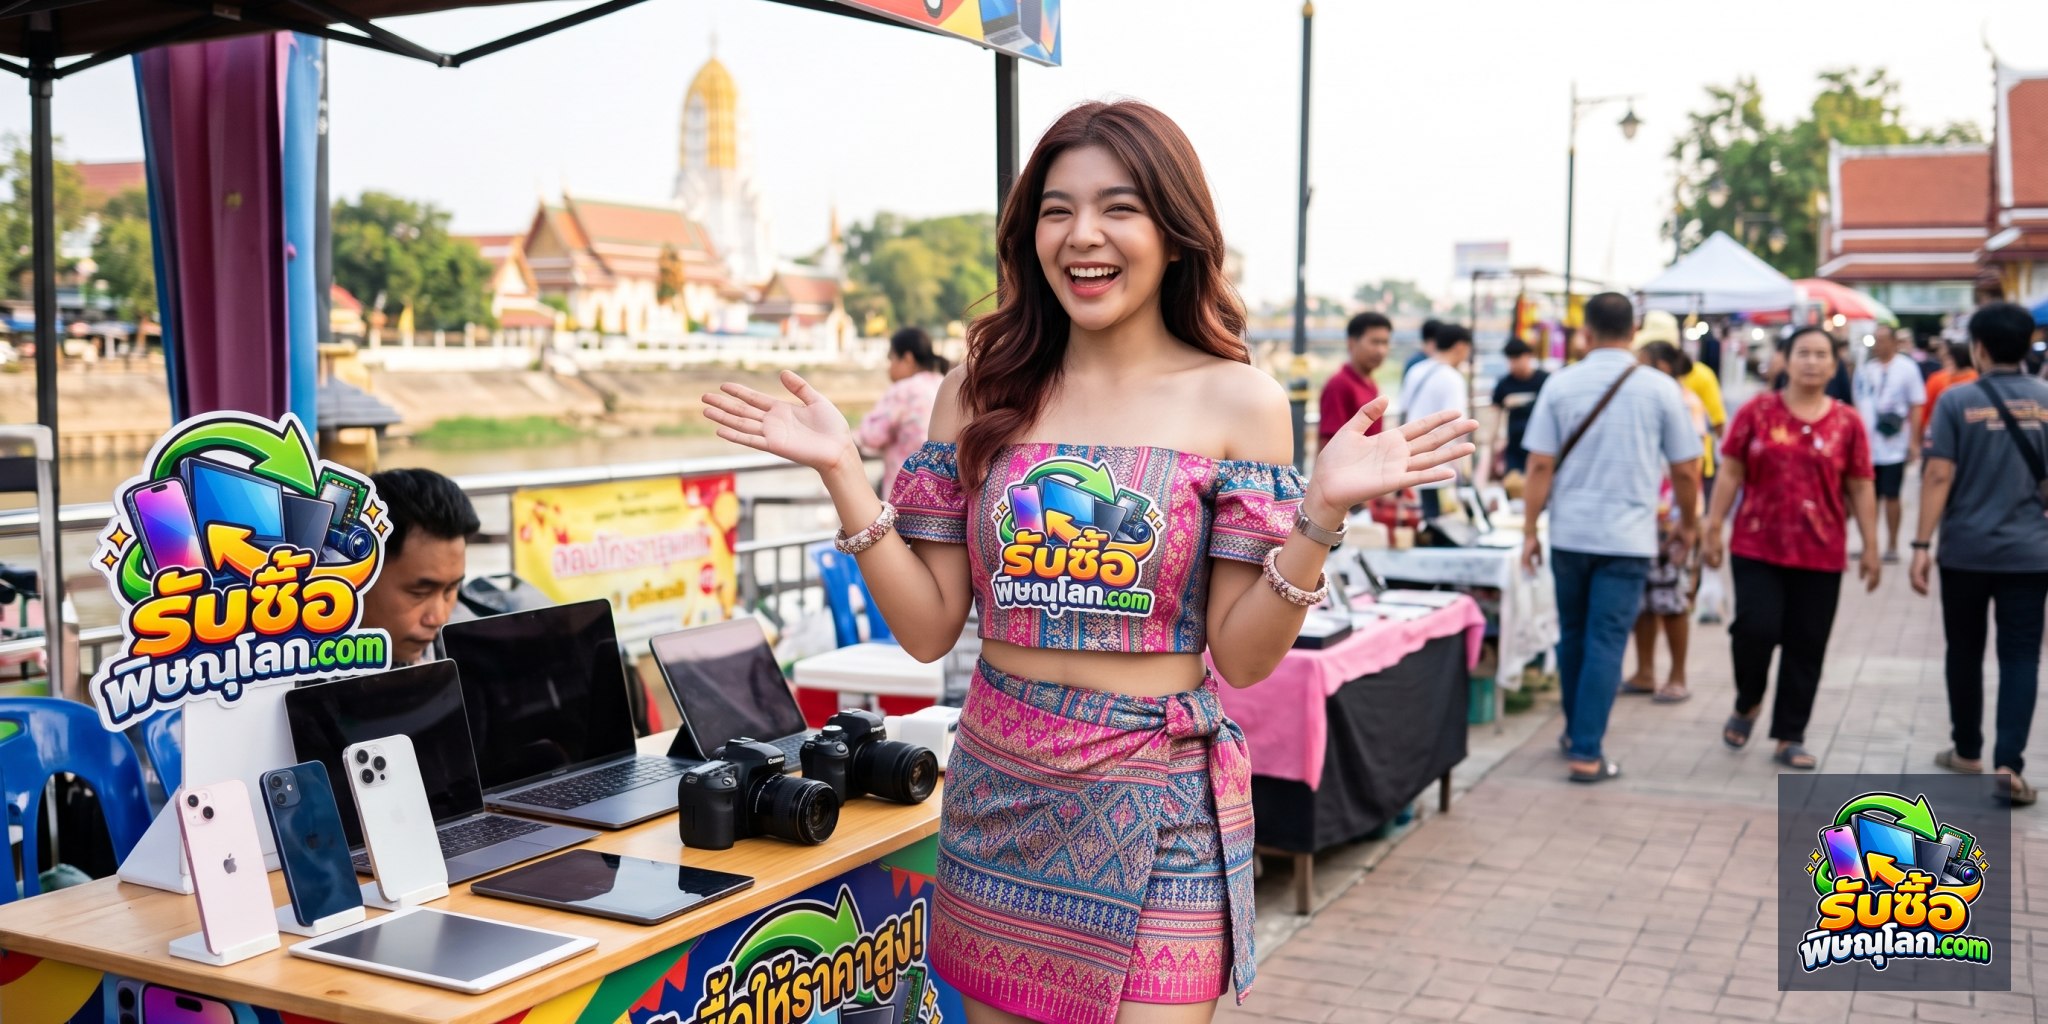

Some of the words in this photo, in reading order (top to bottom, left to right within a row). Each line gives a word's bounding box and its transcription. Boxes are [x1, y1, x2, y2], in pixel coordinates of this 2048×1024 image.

[994, 575, 1150, 612] พิษณุโลก.com
[1003, 529, 1137, 587] รับซื้อ
[131, 549, 355, 658] รับซื้อ
[104, 631, 385, 720] พิษณุโลก.com
